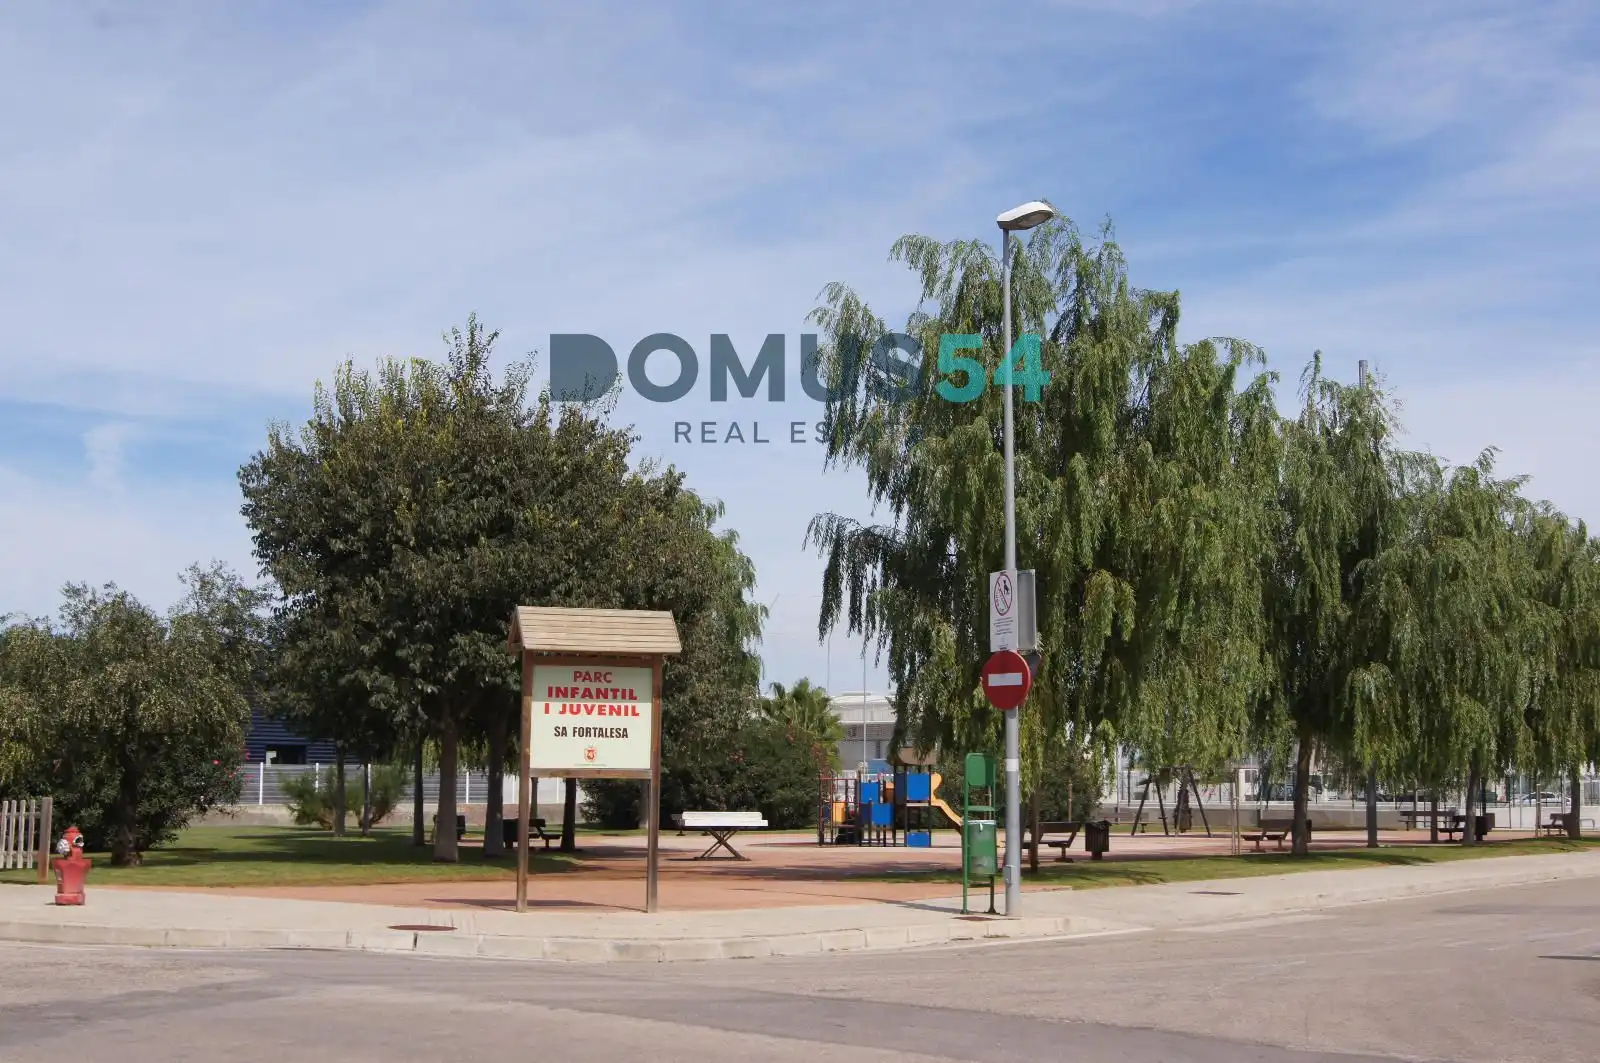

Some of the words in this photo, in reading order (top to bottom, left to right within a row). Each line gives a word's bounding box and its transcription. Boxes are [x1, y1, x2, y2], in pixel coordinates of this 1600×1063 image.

[573, 671, 613, 683] PARC
[547, 686, 638, 700] INFANTIL
[544, 703, 550, 715] I
[559, 703, 640, 716] JUVENIL
[554, 726, 568, 737] SA
[572, 726, 629, 738] FORTALESA
